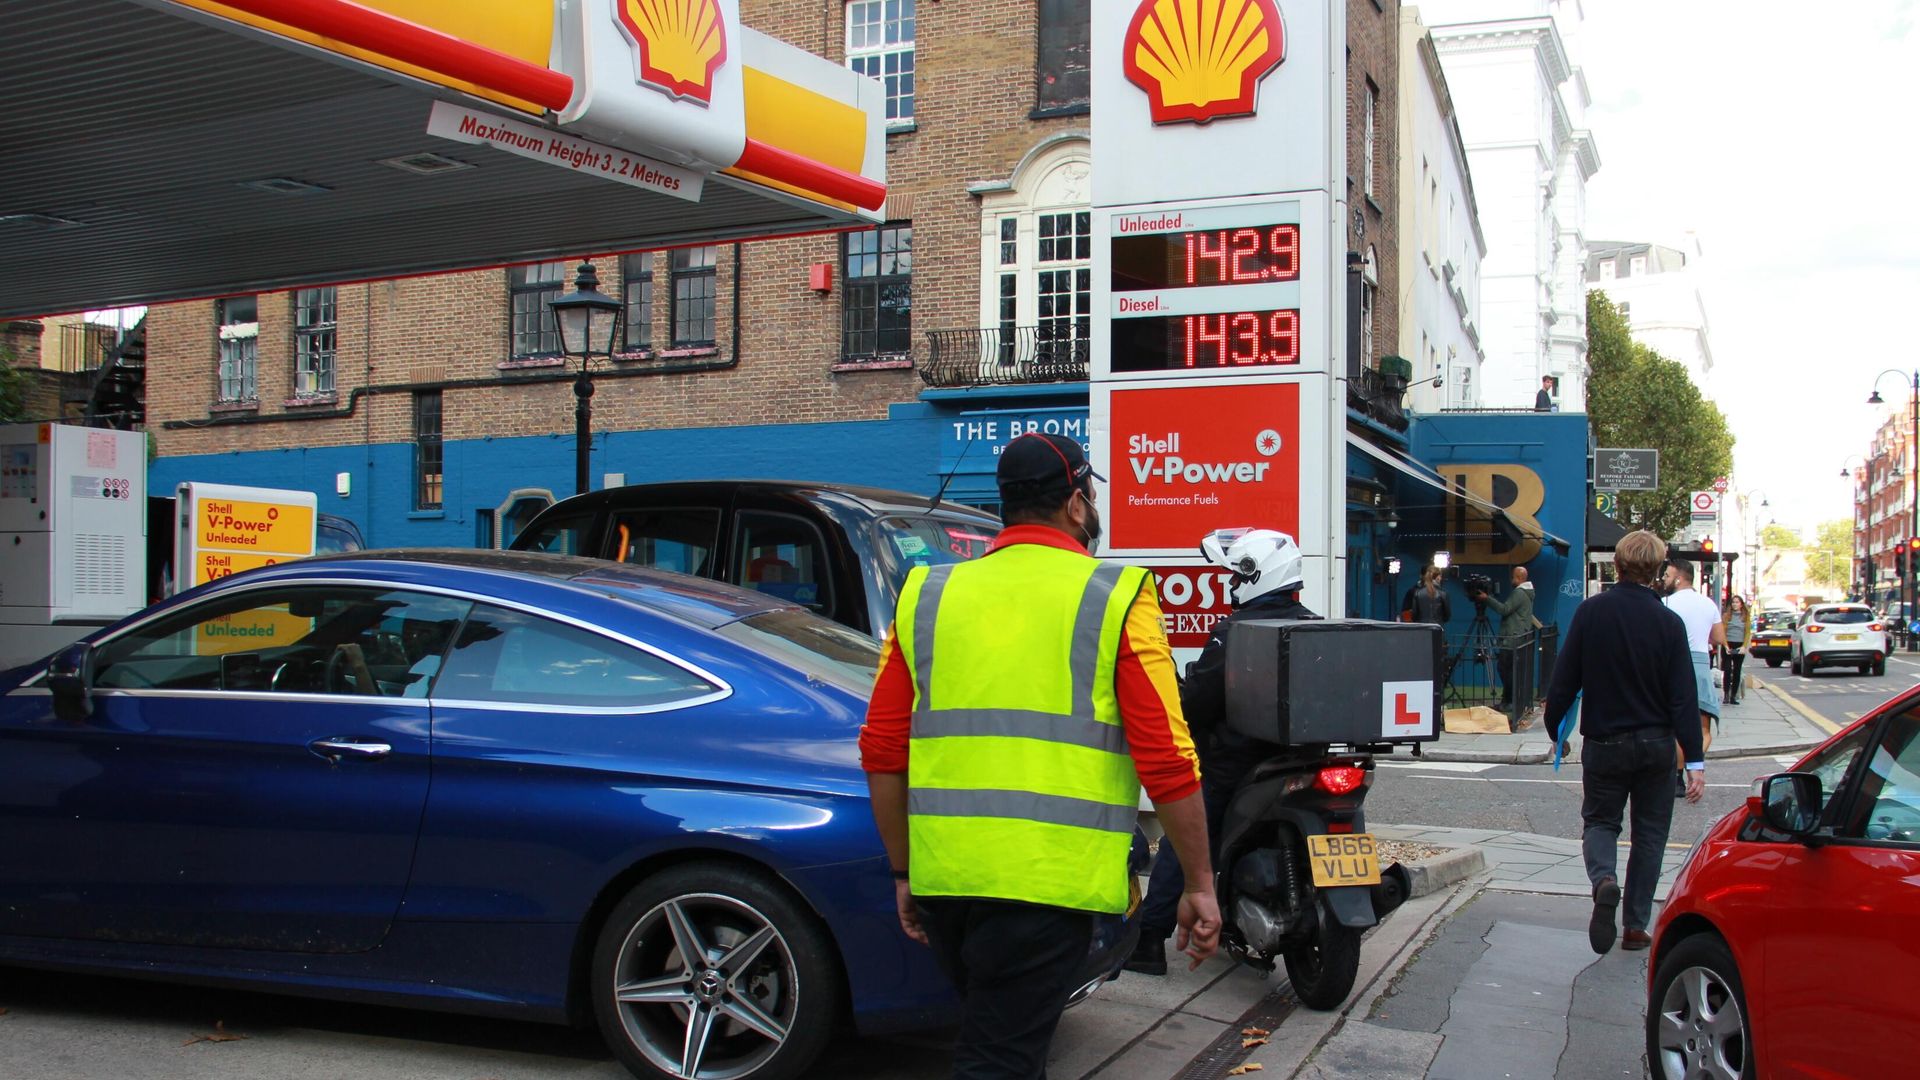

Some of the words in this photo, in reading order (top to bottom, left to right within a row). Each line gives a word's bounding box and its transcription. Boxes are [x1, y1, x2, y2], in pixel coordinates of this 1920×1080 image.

[459, 115, 544, 153] Maximum
[547, 138, 601, 169] Height
[630, 162, 681, 191] Metres
[1119, 213, 1182, 233] Unleaded
[1185, 226, 1298, 284] 142.9
[1119, 296, 1159, 312] Diesel
[1185, 311, 1298, 366] 143.9
[953, 422, 997, 440] THE
[1128, 432, 1180, 454] Shell
[1129, 456, 1270, 484] V-Power
[207, 503, 233, 514] Shell
[1128, 493, 1191, 506] Performance
[1193, 493, 1219, 505] Fuels
[208, 514, 273, 532] V-Power
[206, 532, 257, 545] Unleaded
[206, 555, 231, 567] Shell
[206, 568, 232, 581] V-P
[1156, 573, 1234, 609] OST
[205, 623, 275, 637] Unleaded
[1176, 613, 1228, 633] EXP
[1394, 693, 1421, 725] L
[1311, 836, 1373, 857] LB66
[1323, 858, 1369, 878] VLU
